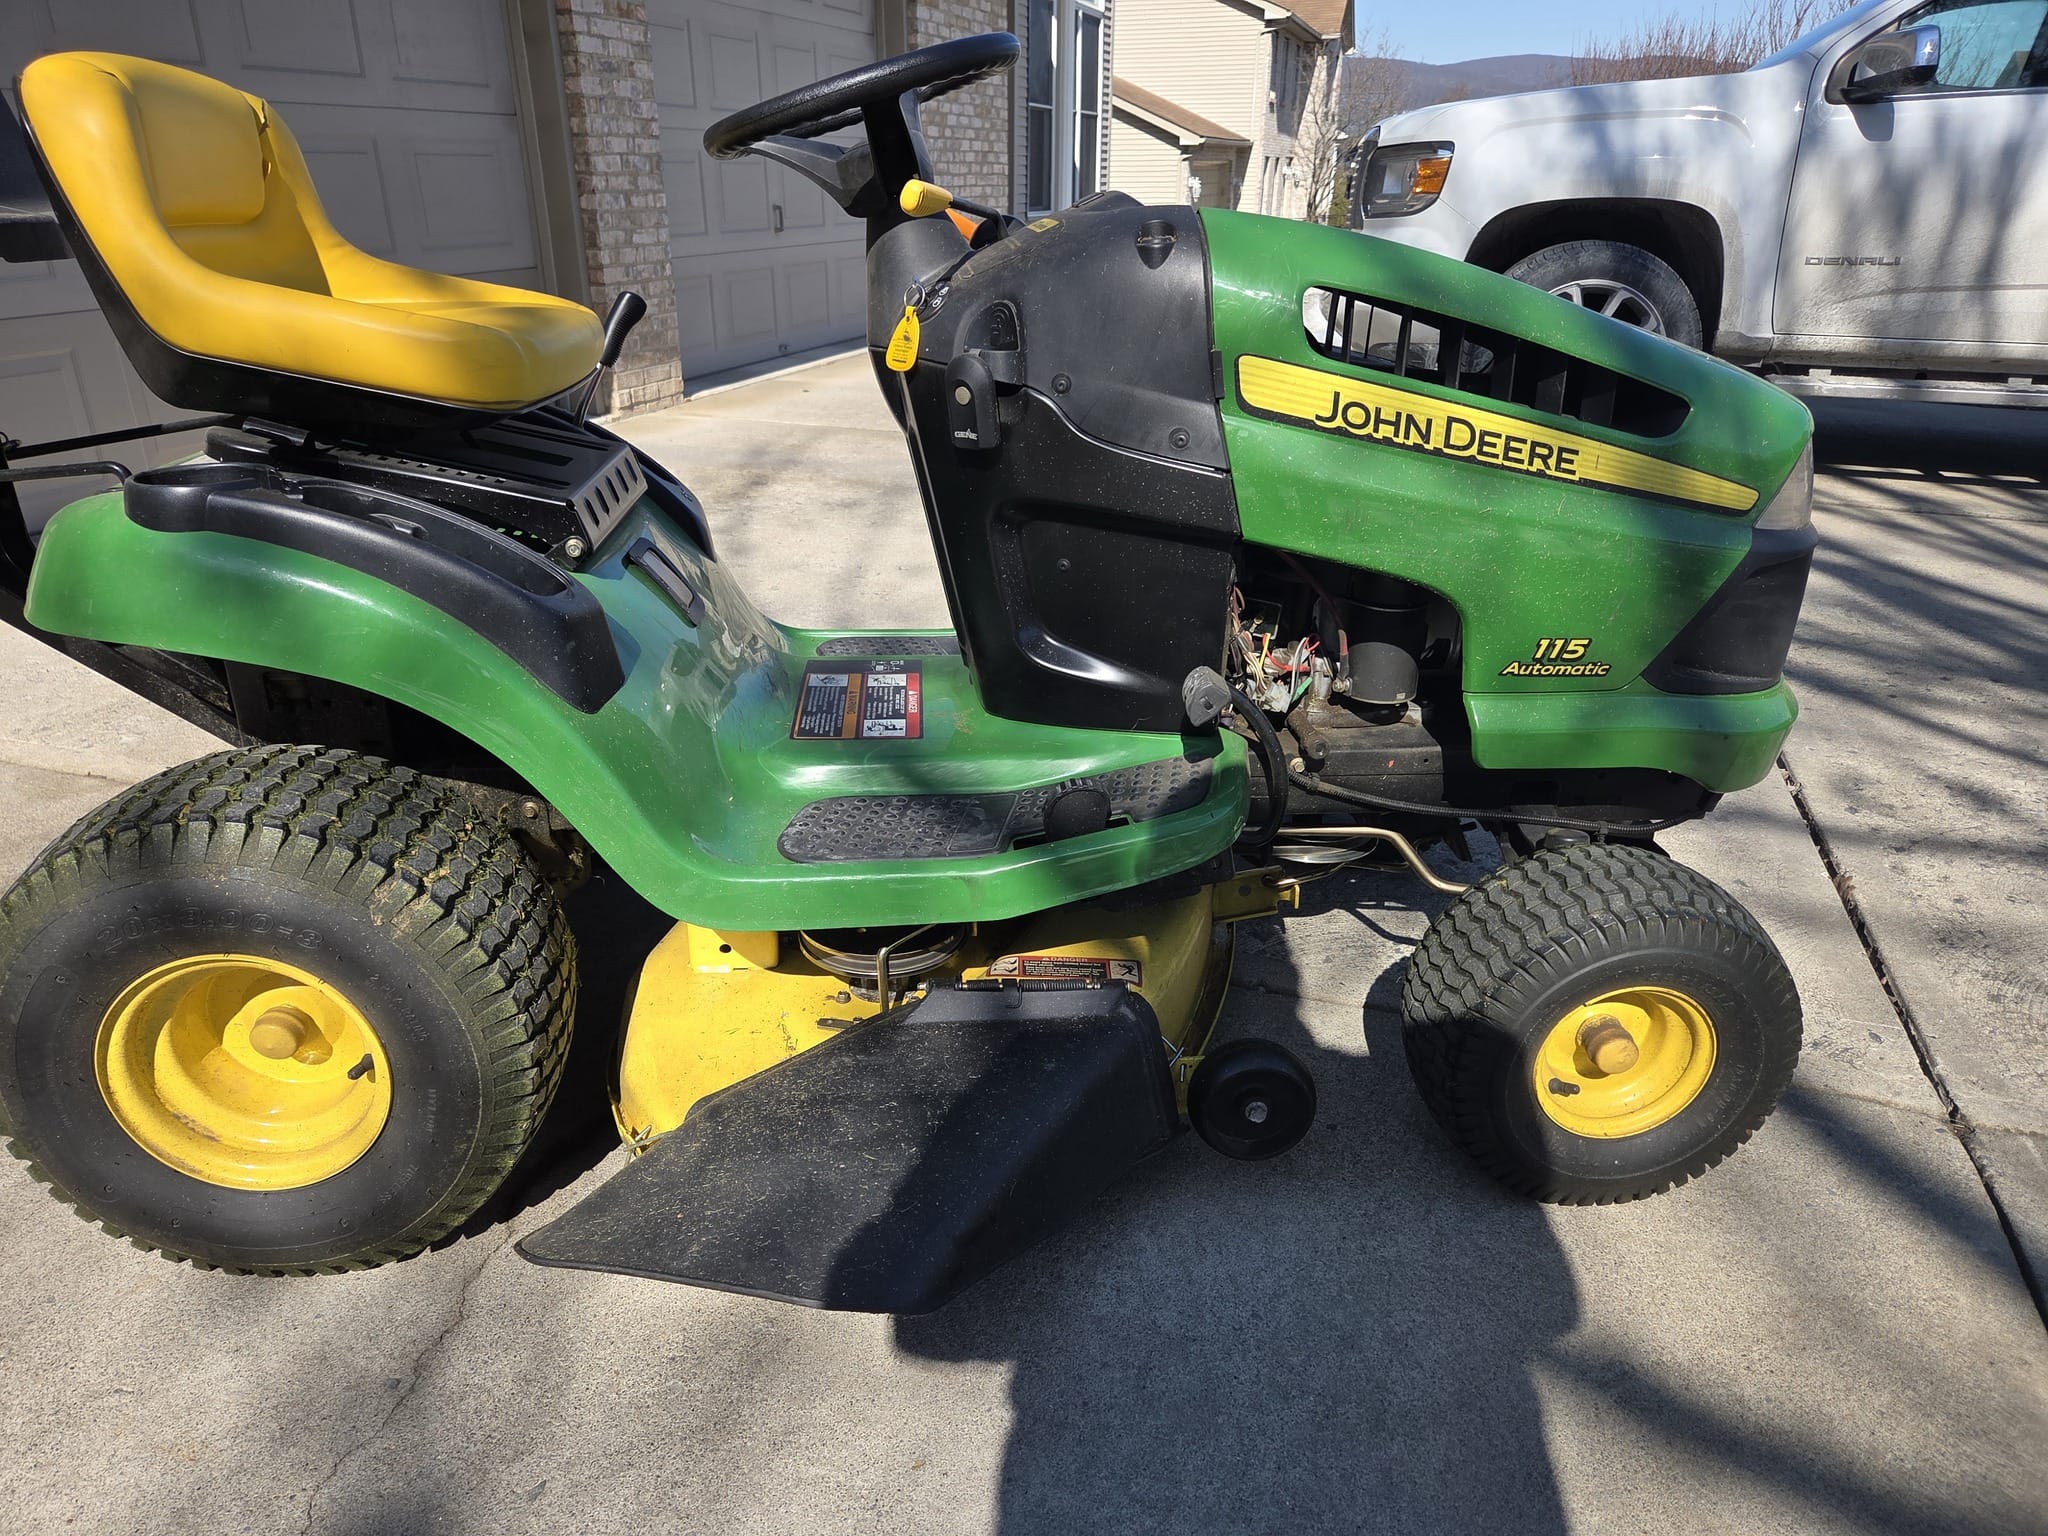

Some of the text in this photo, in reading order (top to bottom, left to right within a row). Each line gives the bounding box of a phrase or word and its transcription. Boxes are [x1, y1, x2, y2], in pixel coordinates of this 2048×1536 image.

[1803, 255, 1902, 266] DENALI
[1314, 390, 1581, 477] JOHN DEERE
[1533, 638, 1591, 661] 115
[1501, 661, 1611, 676] Automatic
